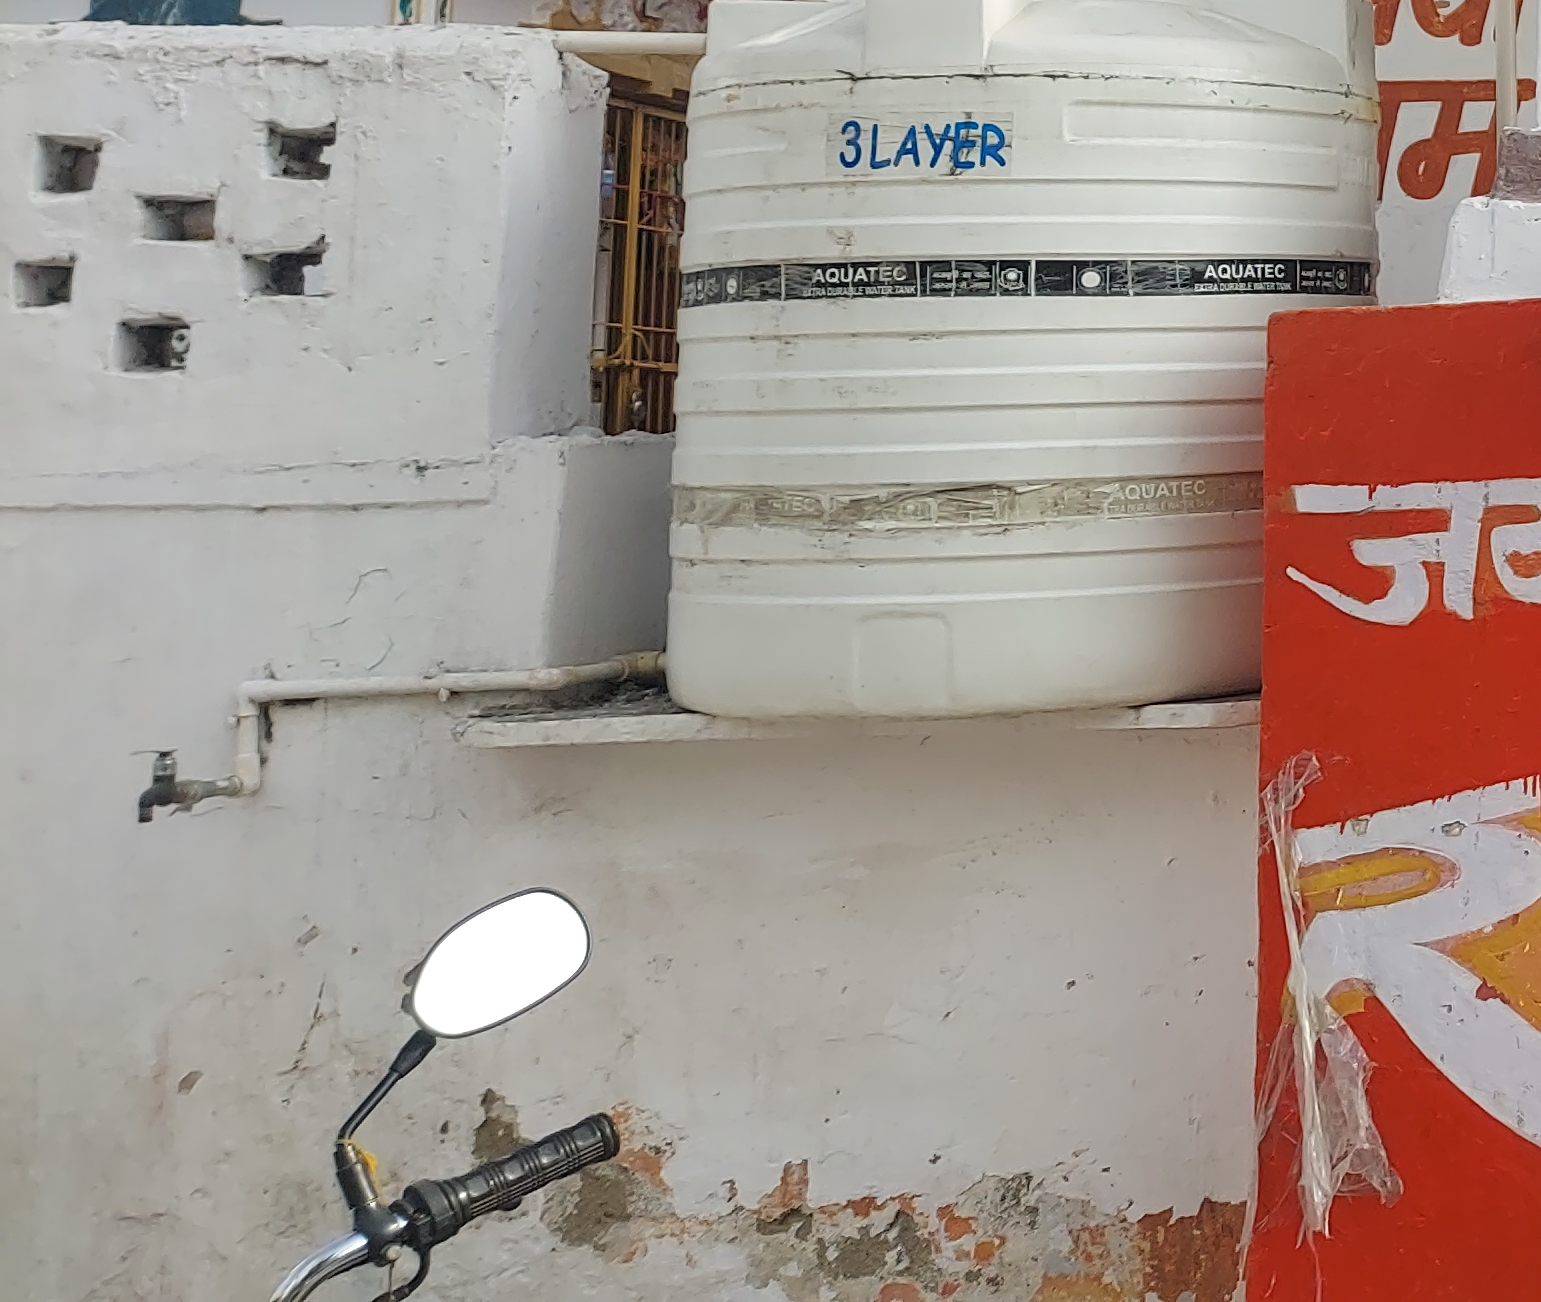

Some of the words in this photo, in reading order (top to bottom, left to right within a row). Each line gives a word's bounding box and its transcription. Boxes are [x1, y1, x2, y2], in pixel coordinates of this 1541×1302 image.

[869, 119, 1008, 171] LAYER
[811, 265, 909, 285] AQUATEC
[1203, 262, 1286, 280] AQUATEC
